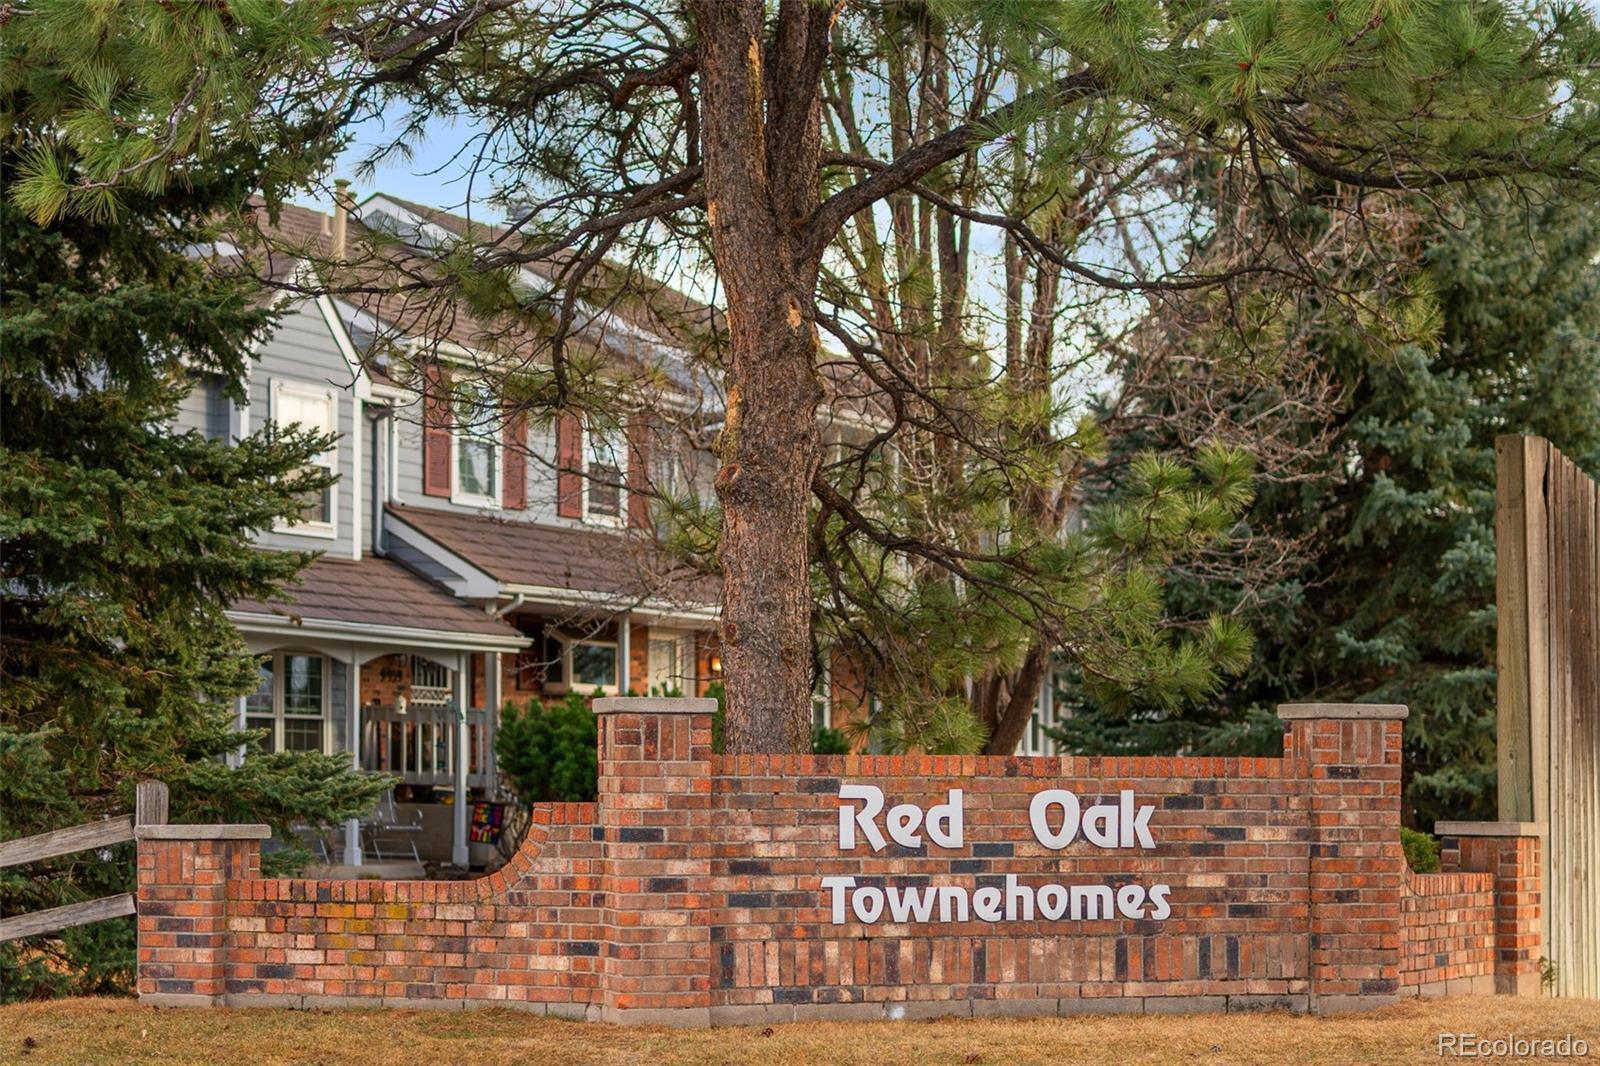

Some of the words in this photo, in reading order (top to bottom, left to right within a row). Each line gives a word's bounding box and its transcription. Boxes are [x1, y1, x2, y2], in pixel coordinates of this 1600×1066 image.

[838, 785, 964, 852] Red
[1029, 789, 1157, 850] Oak
[821, 873, 1172, 925] Townehomes
